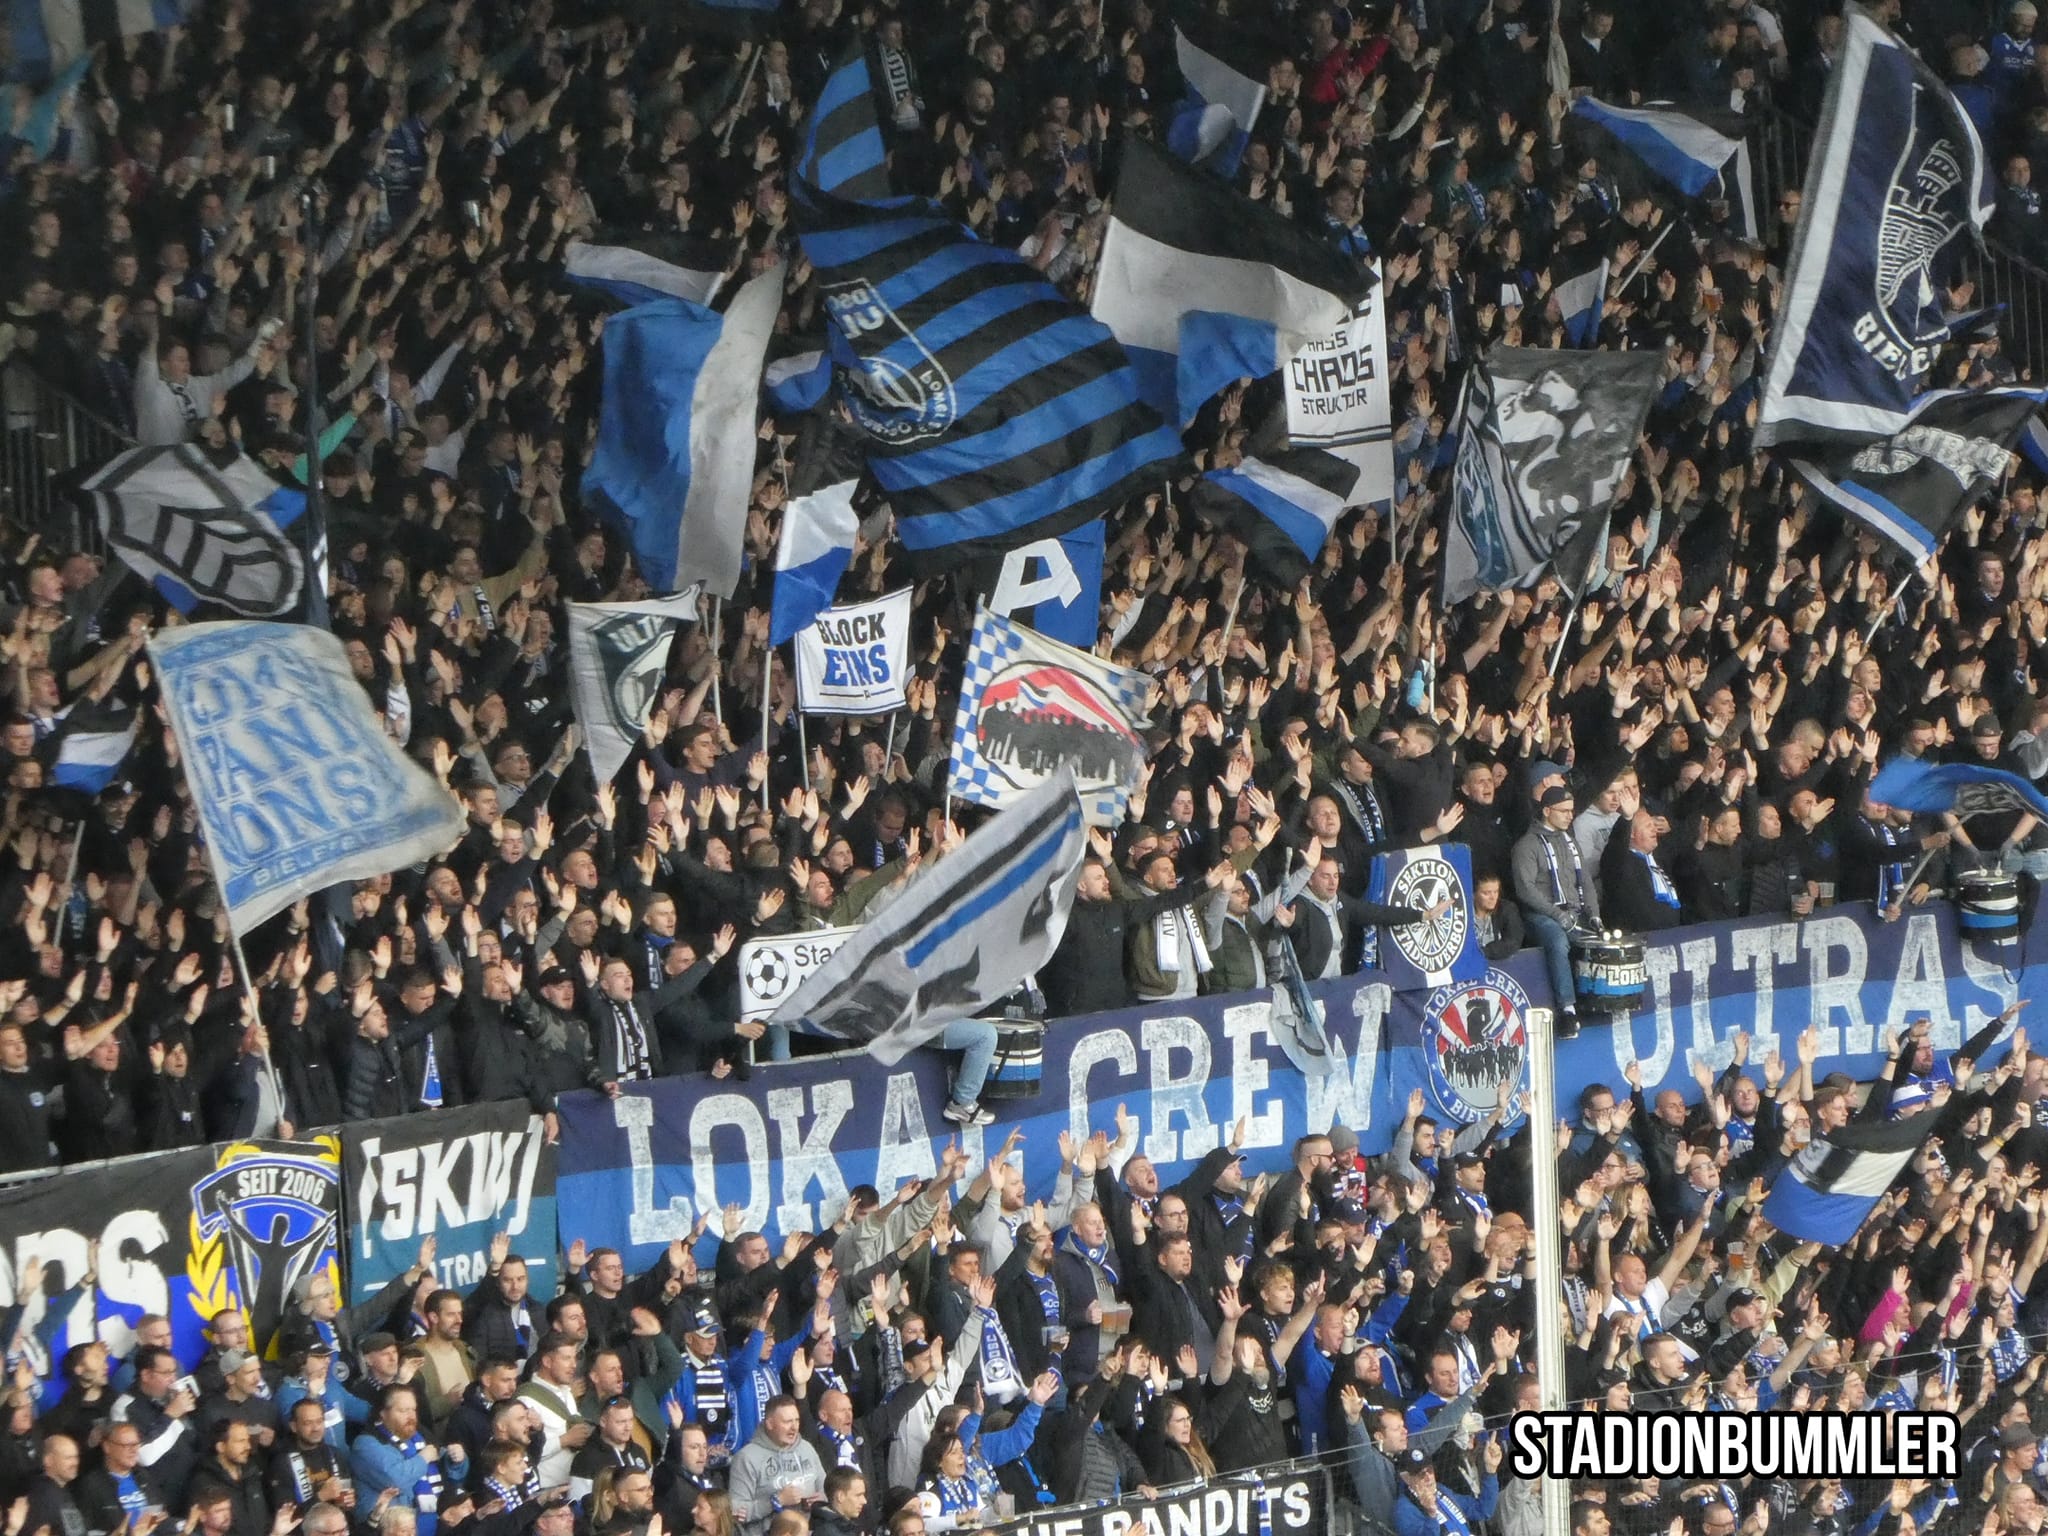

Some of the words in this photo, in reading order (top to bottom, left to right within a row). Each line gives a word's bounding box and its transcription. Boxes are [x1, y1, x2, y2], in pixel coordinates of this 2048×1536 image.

[1291, 344, 1375, 393] CHAOS
[816, 611, 886, 647] BLOCK
[822, 644, 890, 687] EINS
[1397, 861, 1456, 895] SEKTION
[794, 941, 847, 967] Sta
[1485, 970, 1526, 1007] CREW
[1069, 982, 1392, 1182] CREW
[1612, 914, 2020, 1089] ULTRAS
[237, 1169, 277, 1198] SEIT
[281, 1170, 327, 1205] 2006
